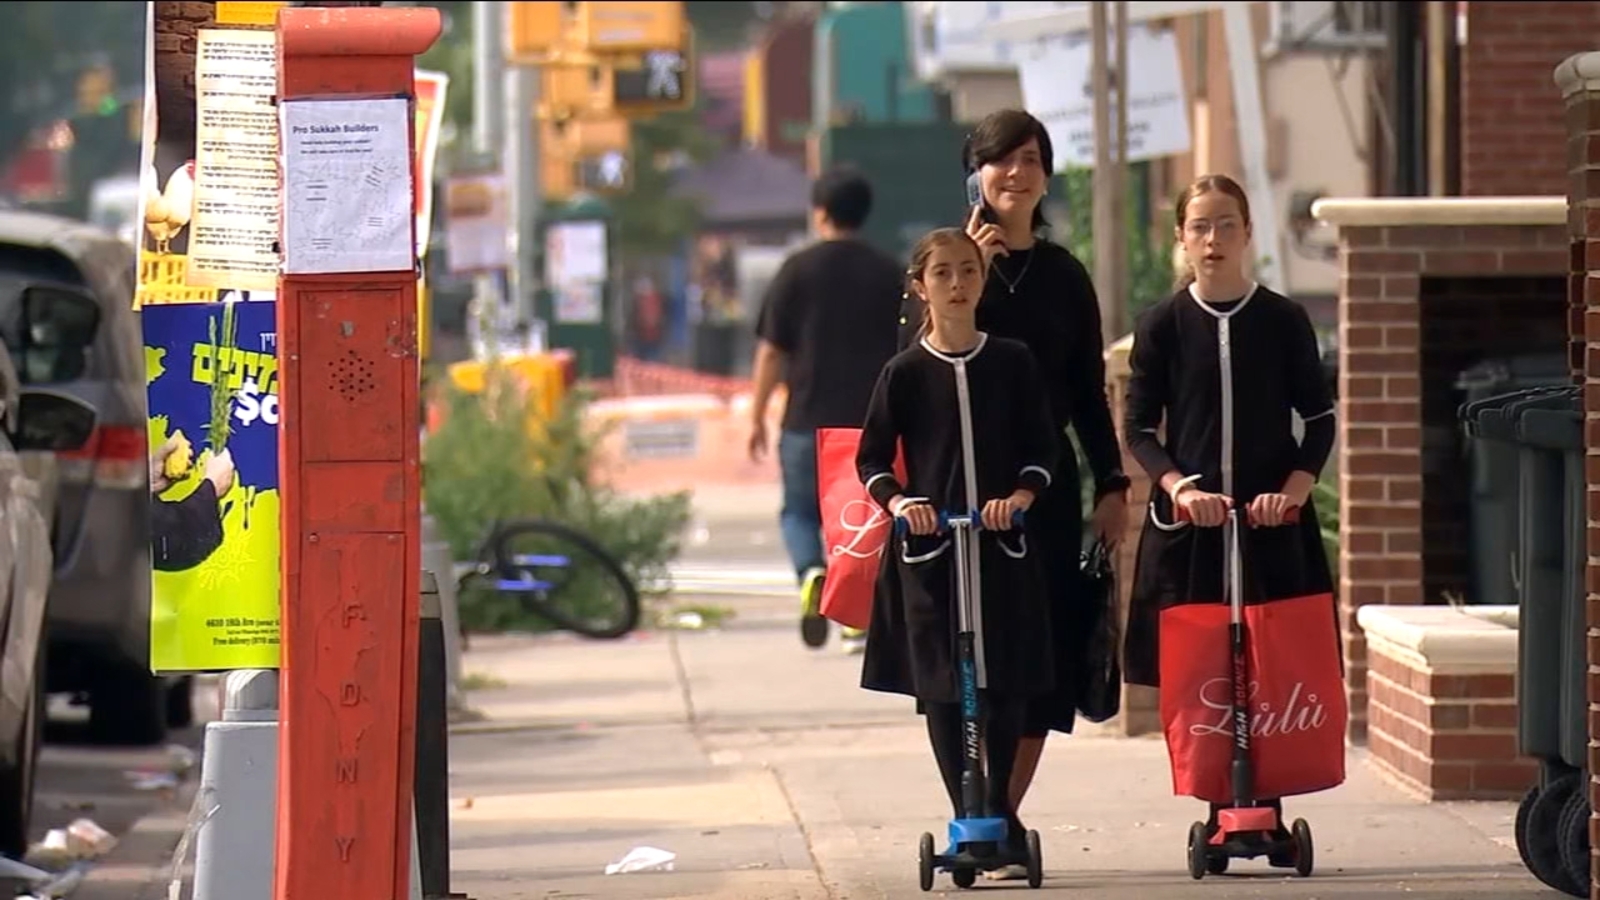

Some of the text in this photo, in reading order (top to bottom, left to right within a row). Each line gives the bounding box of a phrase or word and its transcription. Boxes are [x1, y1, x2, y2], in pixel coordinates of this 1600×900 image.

[292, 123, 379, 134] Pro Sukkah Builders
[213, 637, 227, 646] Free
[965, 721, 980, 760] HIGH
